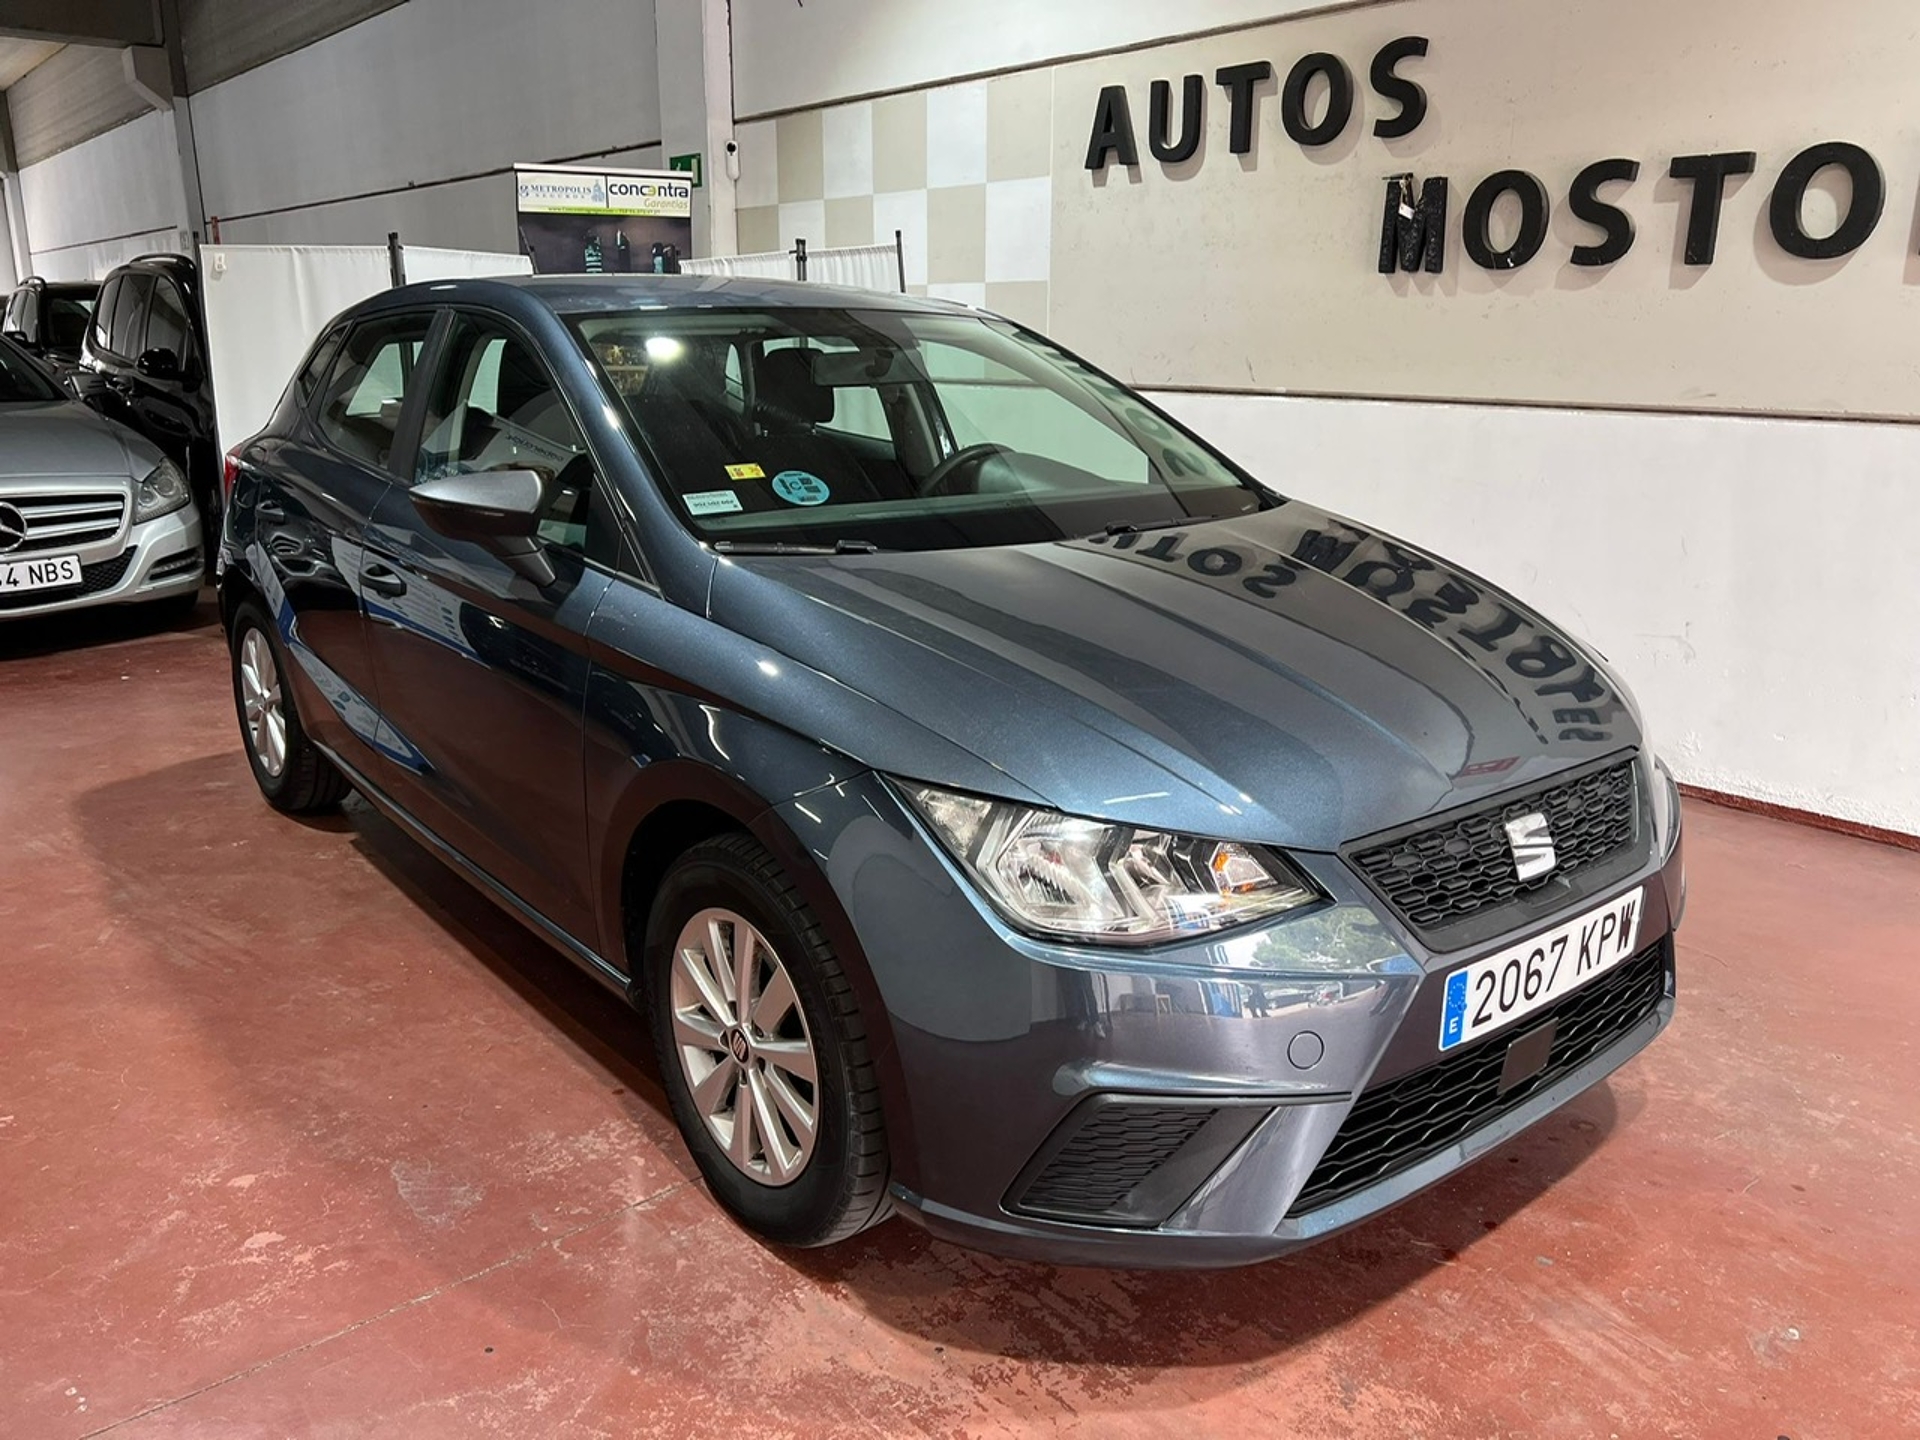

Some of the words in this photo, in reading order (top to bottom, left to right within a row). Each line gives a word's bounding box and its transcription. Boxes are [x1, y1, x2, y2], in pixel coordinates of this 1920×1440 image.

[1084, 36, 1430, 169] AUTOS
[530, 184, 592, 194] METROPOLIS
[608, 182, 689, 199] concentra
[1377, 141, 1920, 276] MOSTO
[28, 560, 74, 585] NBS
[1471, 934, 1569, 1029] 2067
[1576, 899, 1637, 977] KPW
